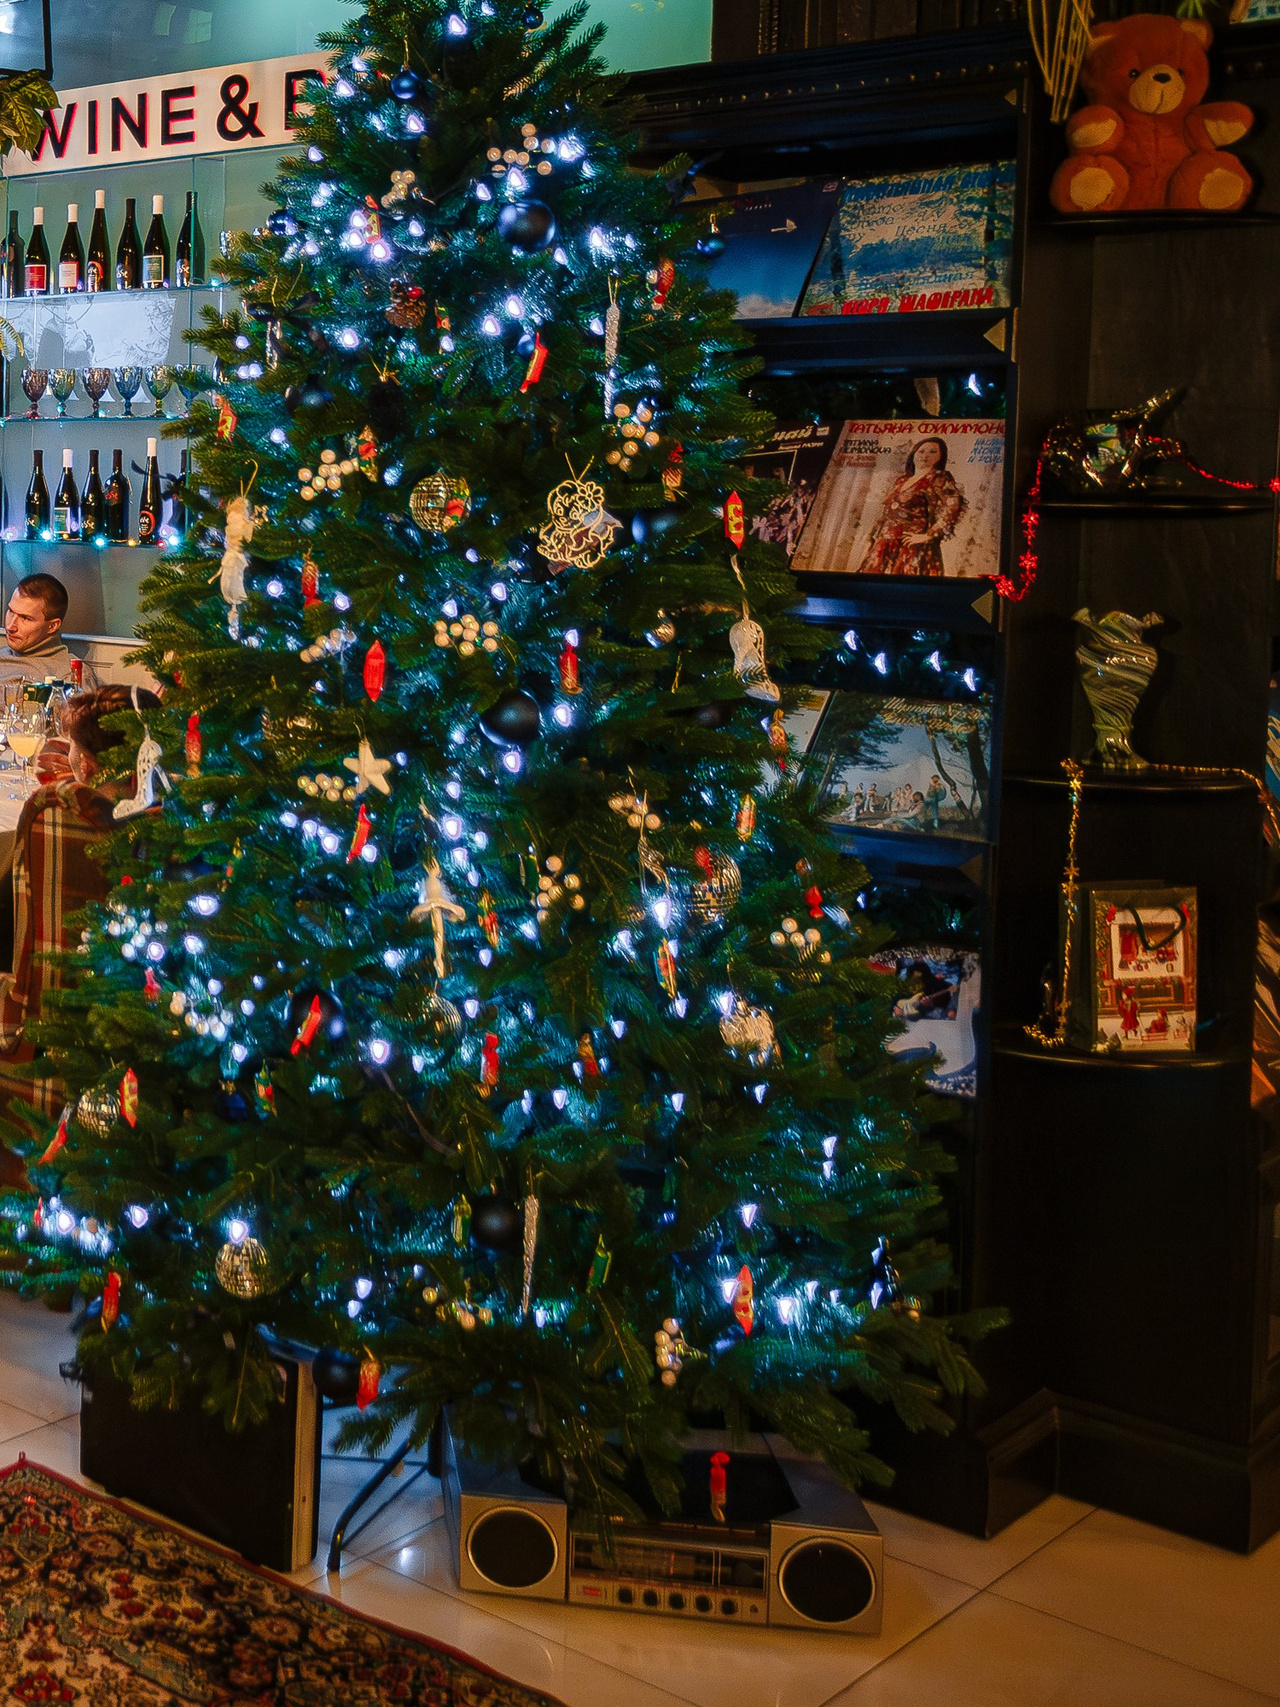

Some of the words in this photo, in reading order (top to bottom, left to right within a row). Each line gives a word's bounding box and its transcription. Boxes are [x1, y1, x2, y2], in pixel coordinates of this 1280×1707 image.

[32, 85, 195, 161] WINE
[217, 74, 265, 142] &
[848, 422, 913, 434] ТАТЬЯНА
